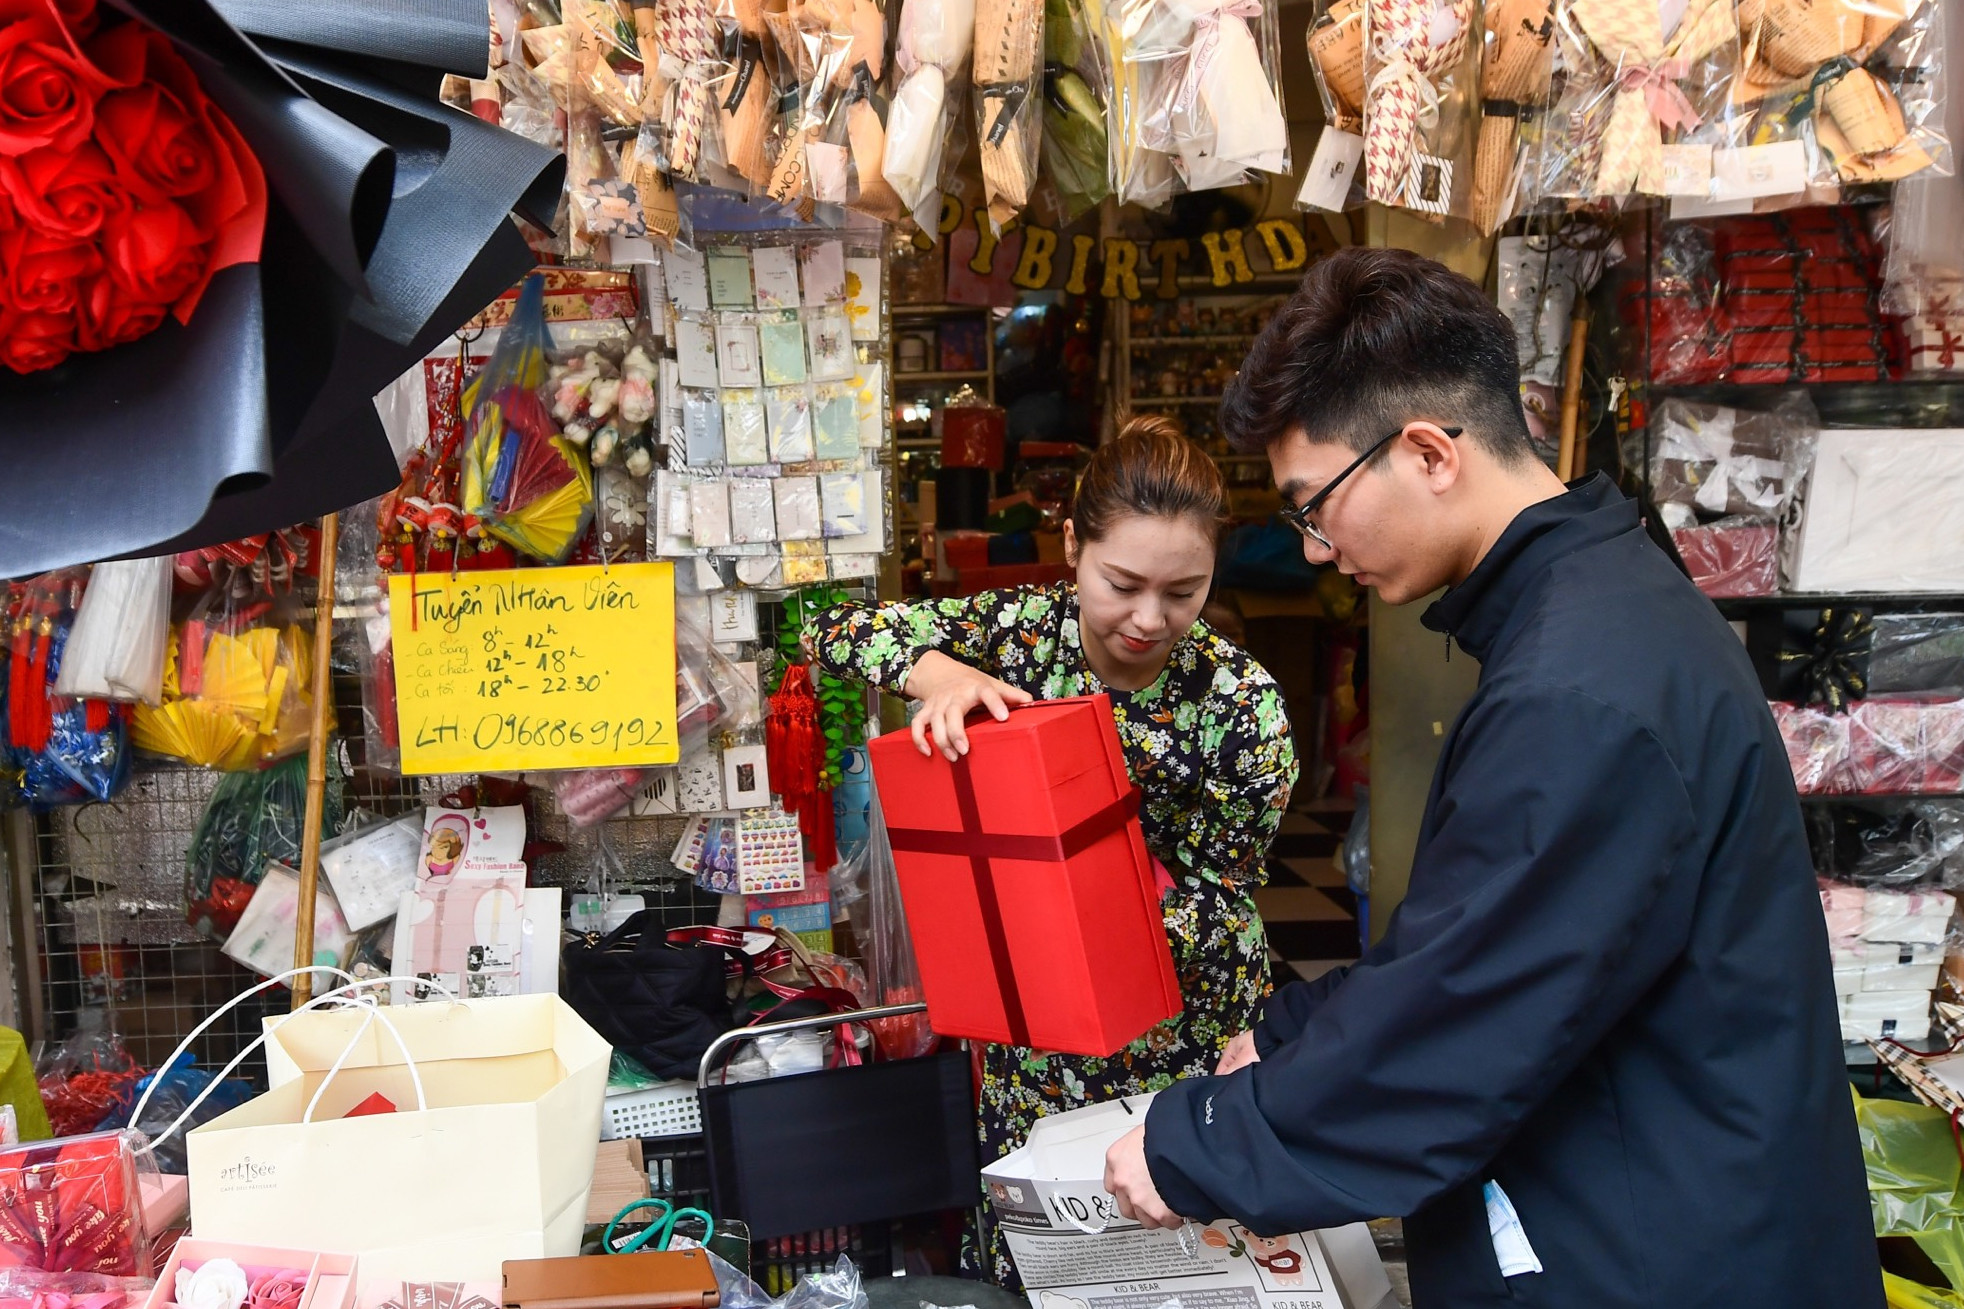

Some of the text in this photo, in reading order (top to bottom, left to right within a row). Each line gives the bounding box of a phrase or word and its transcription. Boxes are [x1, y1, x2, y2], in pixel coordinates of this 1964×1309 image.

[416, 713, 669, 752] LH: 0968869192
[1139, 1283, 1160, 1292] BEAR
[1300, 1301, 1322, 1309] BEAR
